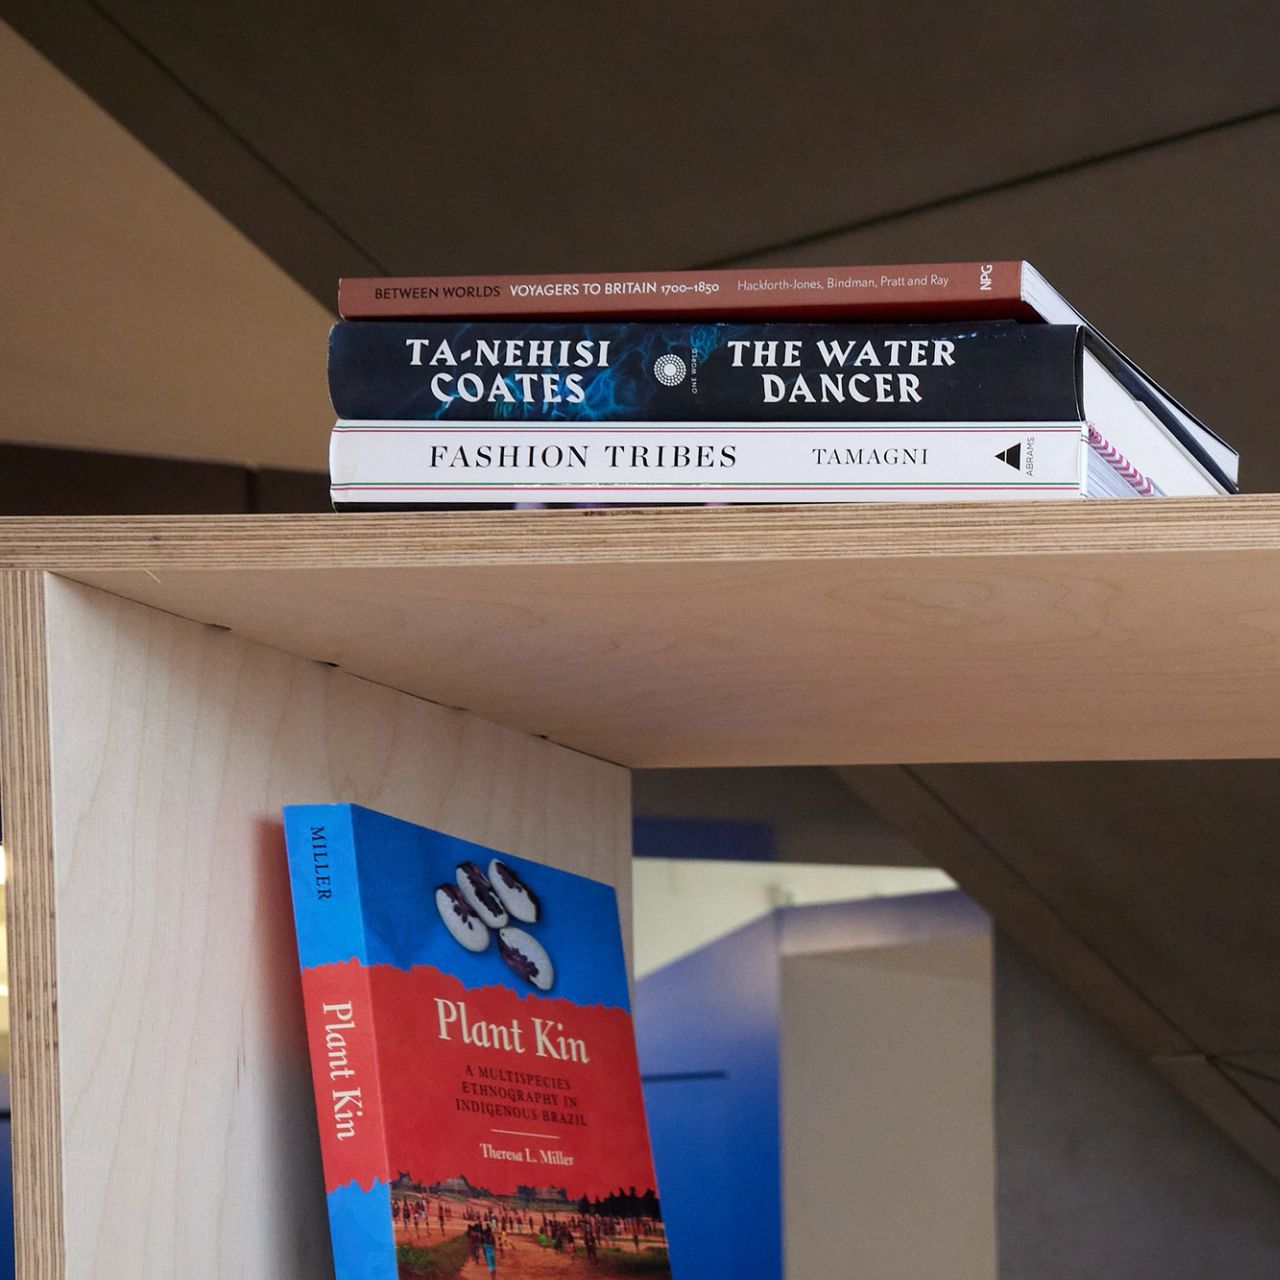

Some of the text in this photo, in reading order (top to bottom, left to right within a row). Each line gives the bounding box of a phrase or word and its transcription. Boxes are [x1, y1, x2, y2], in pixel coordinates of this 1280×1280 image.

[510, 283, 580, 297] VOYAGERS
[582, 283, 601, 296] TO
[605, 281, 657, 294] BRITAIN
[738, 274, 949, 292] Hackforth-Jones, Bindman, Pratt and Ray
[980, 265, 993, 291] NPG
[375, 285, 501, 300] BETWEEN WORLDS
[406, 339, 610, 368] TA-NEHISI
[691, 348, 699, 375] WORLD
[727, 340, 956, 367] THE WATER
[430, 373, 585, 403] COATES
[761, 373, 923, 403] DANCER
[429, 445, 737, 468] FASHION TRIBES
[812, 448, 929, 465] TAMAGNI
[1025, 436, 1035, 476] ABRAMS
[310, 826, 332, 900] MILLER
[433, 997, 590, 1064] Plant Kin
[322, 1000, 362, 1142] Plant Kin
[465, 1065, 572, 1090] A MULTISPECIES
[462, 1081, 578, 1108] ETHNOGRAPHY IN
[456, 1098, 588, 1127] INDIGENOUS BRAZIL
[480, 1143, 575, 1166] Theresa L. Miller
